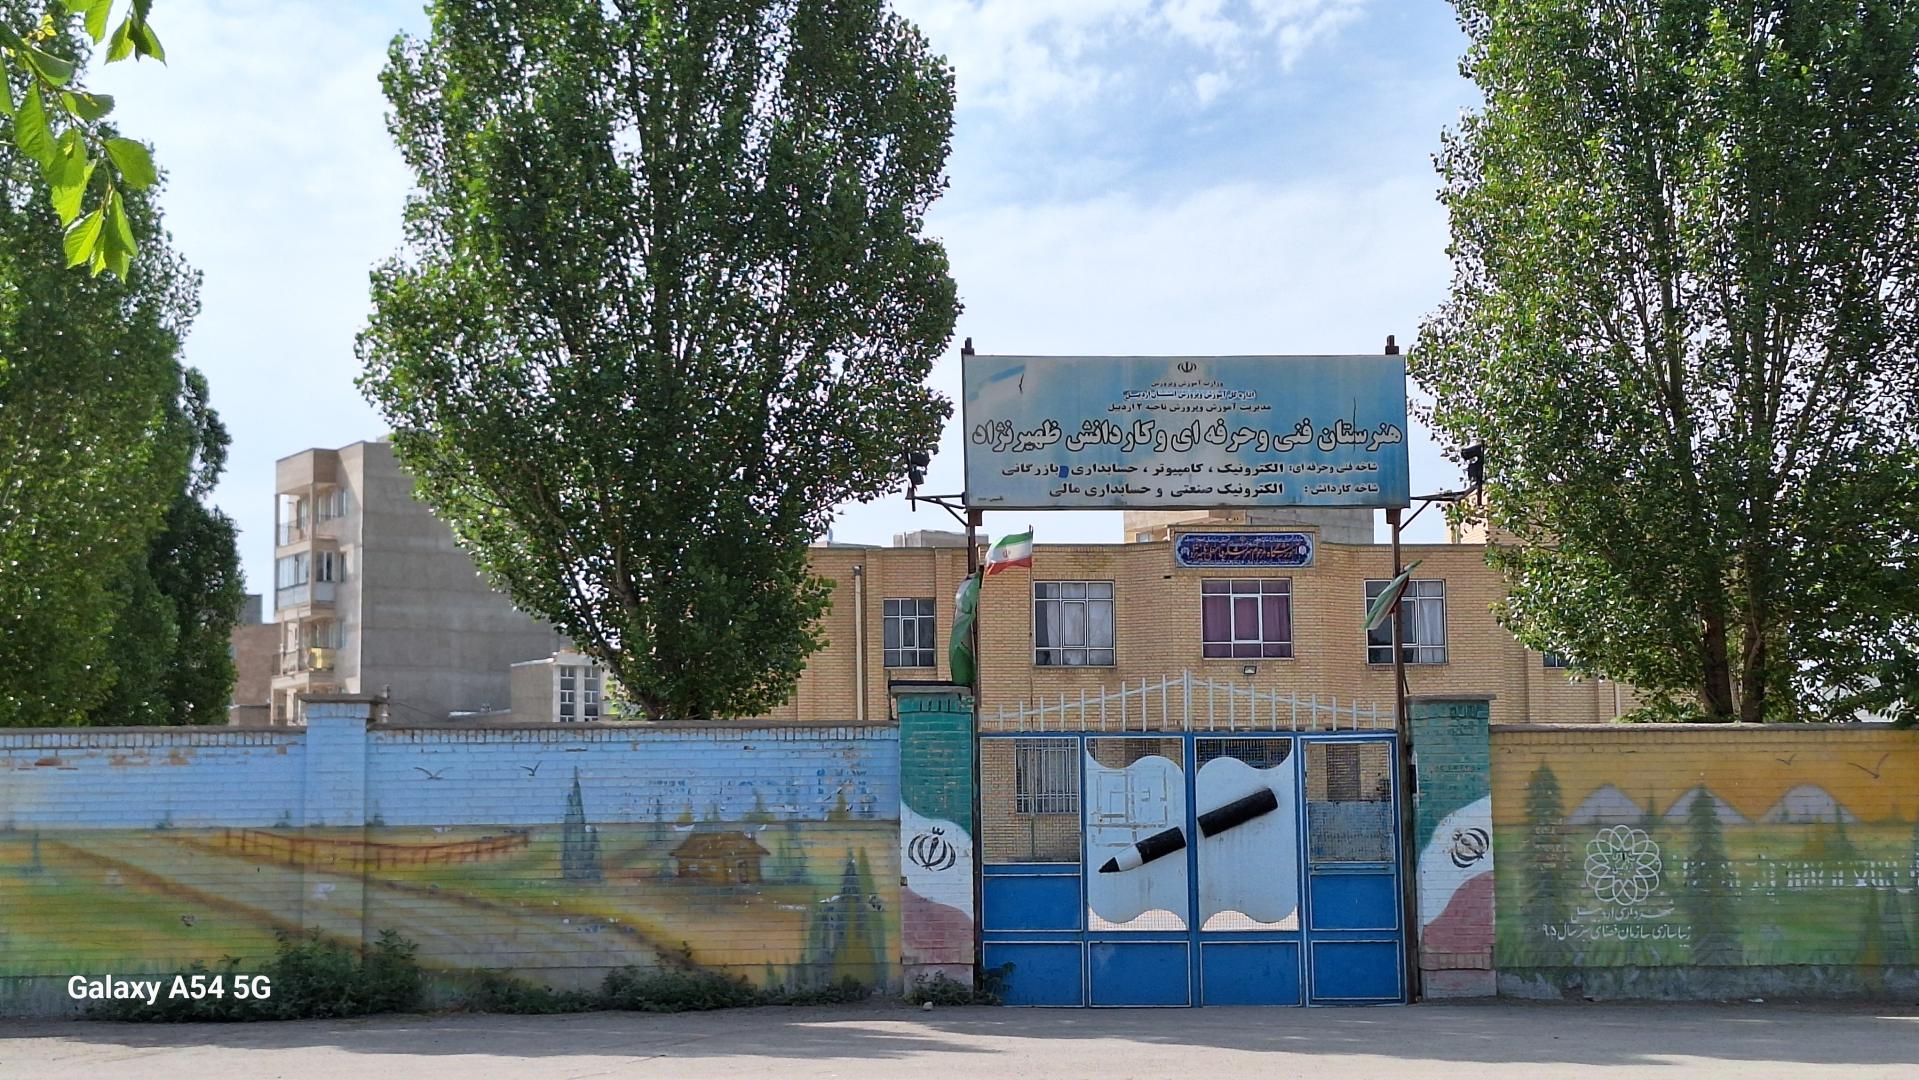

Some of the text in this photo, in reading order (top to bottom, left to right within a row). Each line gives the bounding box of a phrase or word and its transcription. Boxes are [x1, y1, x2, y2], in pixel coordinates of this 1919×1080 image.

[1108, 403, 1135, 412] اردبیل
[1145, 403, 1167, 412] ناحیه
[1206, 402, 1237, 412] آموزش
[1240, 403, 1271, 413] مدیریت
[1273, 418, 1313, 451] فنی
[1317, 418, 1402, 451] هنرستان
[1071, 463, 1138, 476] حسابداری
[1152, 463, 1203, 477] کامپیوتر
[1217, 463, 1283, 476] الکترونیک
[1337, 462, 1353, 473] فنی
[1355, 462, 1377, 471] شاخه
[1049, 483, 1080, 497] مالی
[1084, 483, 1151, 497] حسابداری
[1156, 488, 1163, 497] و
[1170, 484, 1213, 496] صنعتی
[1217, 483, 1283, 497] الکترونیک
[1311, 484, 1351, 495] کاردانش
[1354, 483, 1379, 492] شاخه
[1558, 923, 1577, 941] سال
[1590, 924, 1618, 940] فضای
[1618, 924, 1650, 940] سازمان
